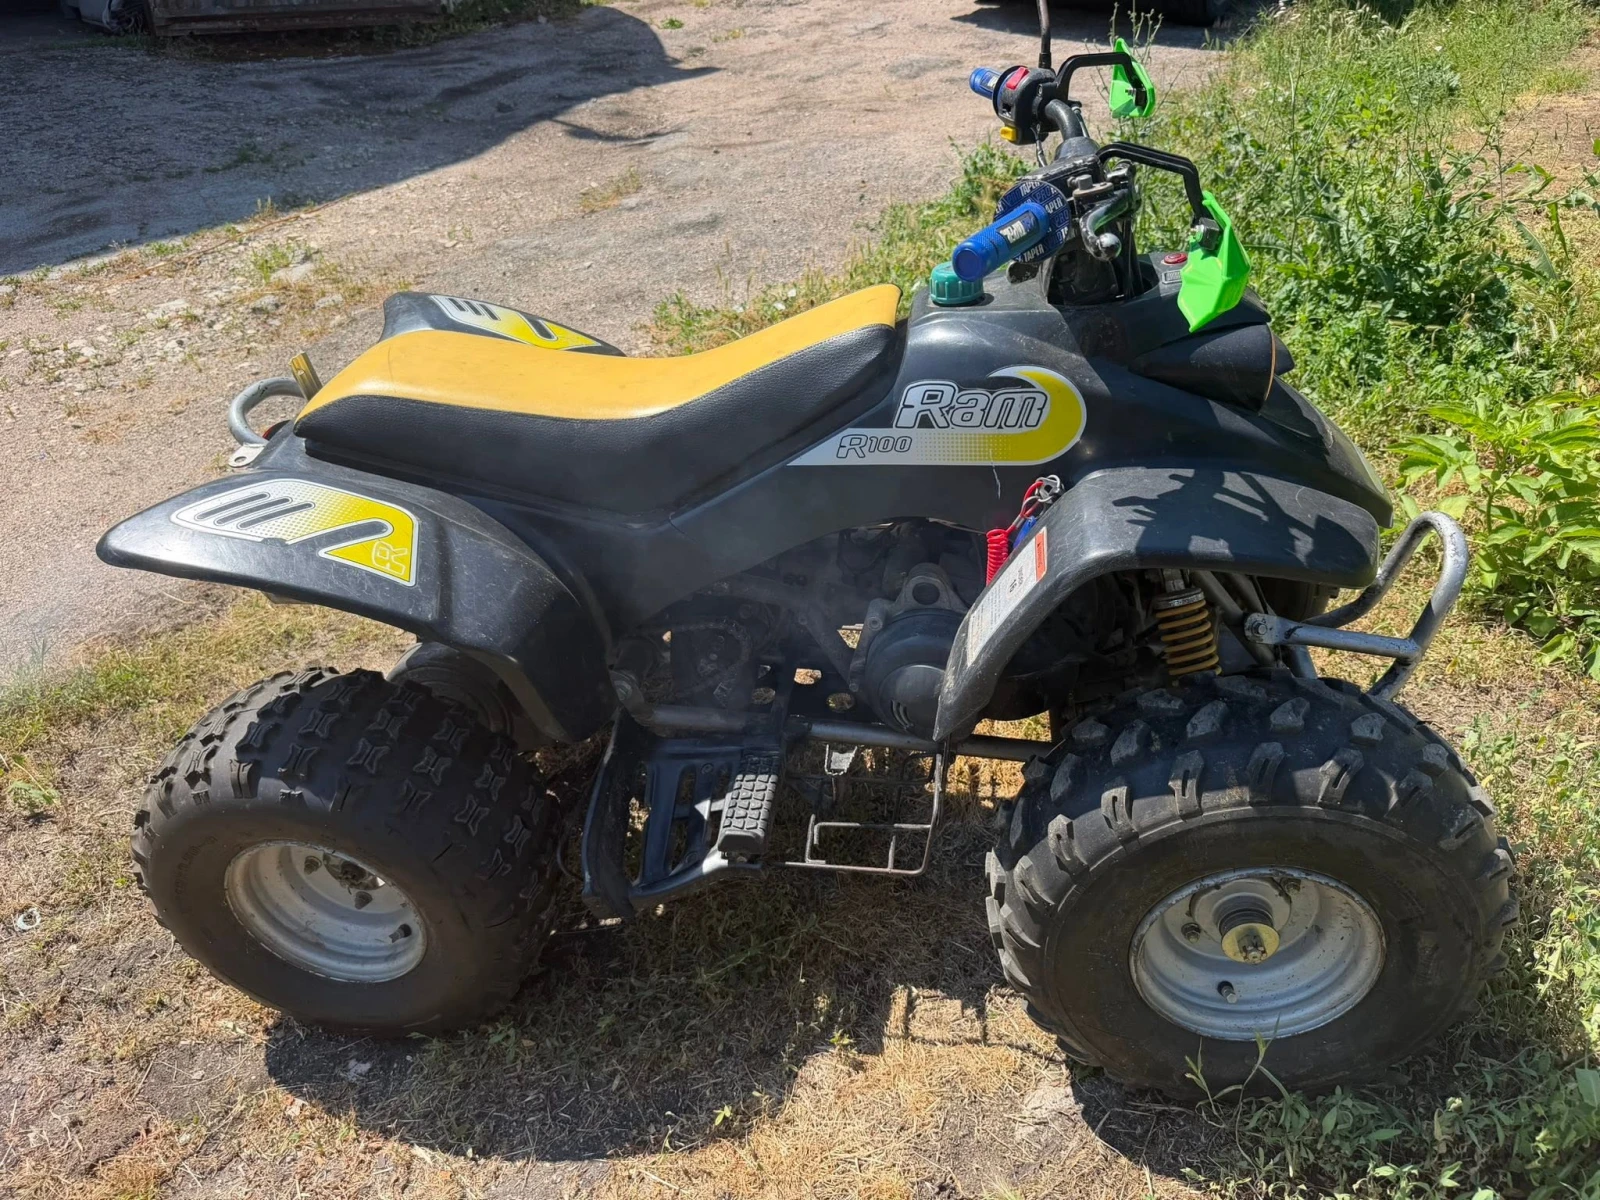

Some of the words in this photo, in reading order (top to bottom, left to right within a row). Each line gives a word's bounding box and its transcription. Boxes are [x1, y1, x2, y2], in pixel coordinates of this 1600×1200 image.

[1045, 197, 1063, 214] APER
[1023, 243, 1044, 262] TAPER
[895, 381, 1048, 430] Ram
[836, 434, 912, 459] R100
